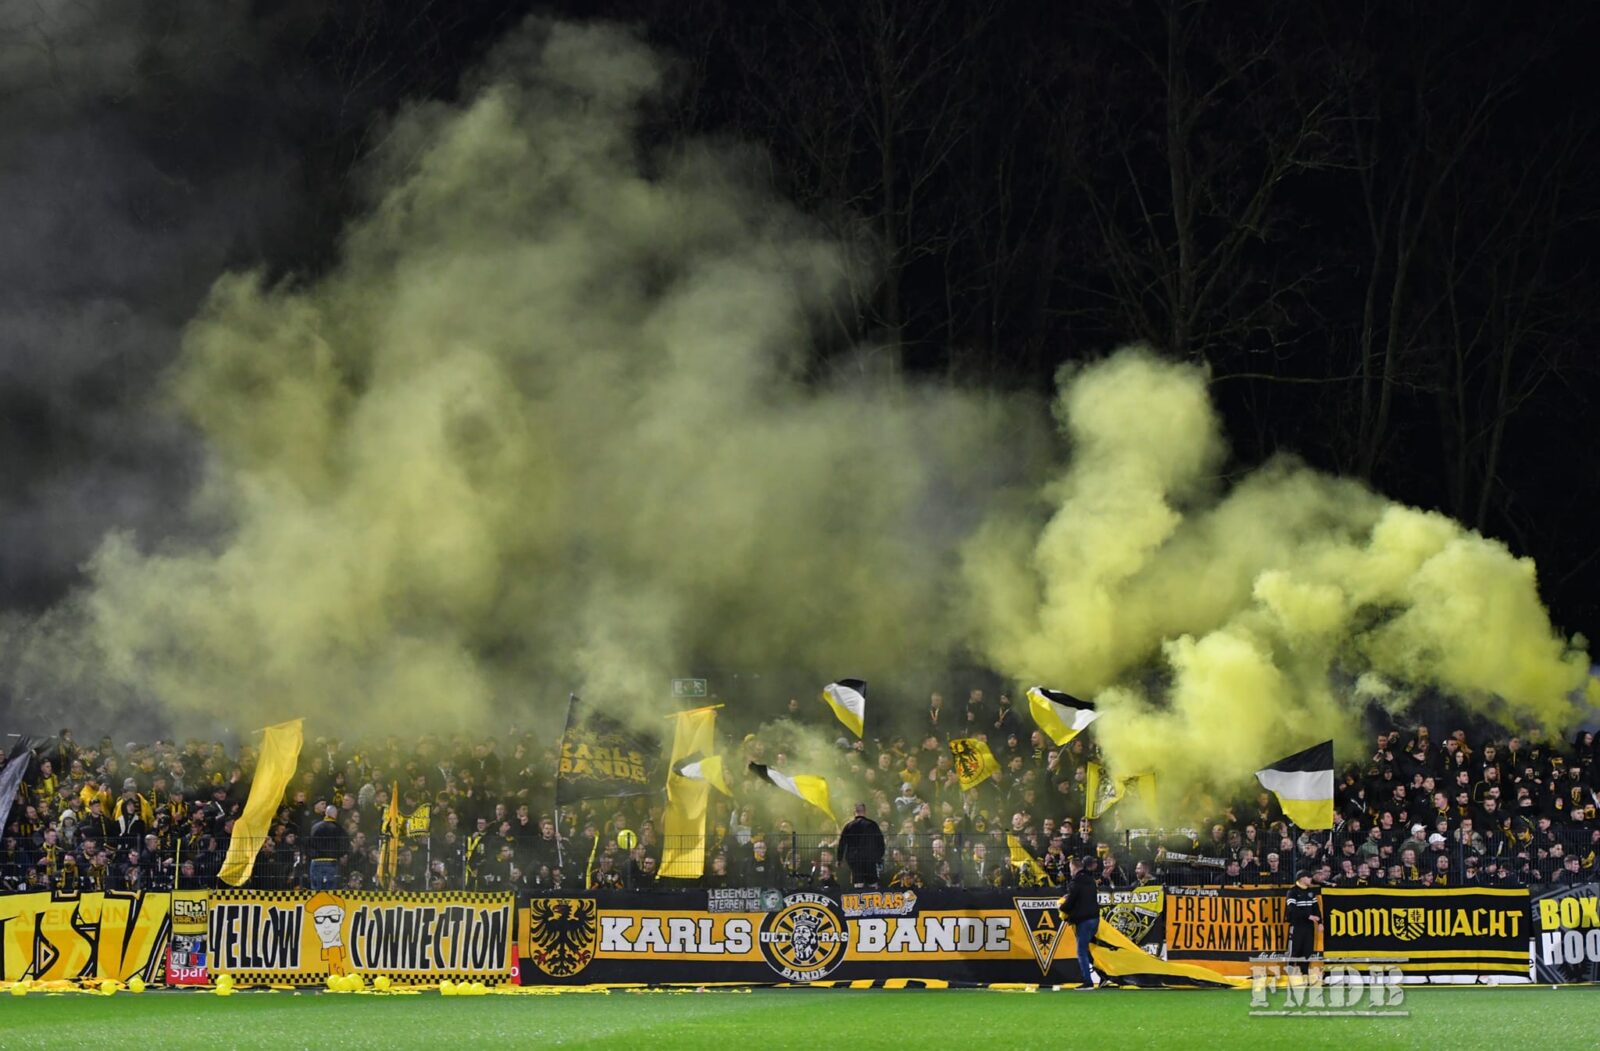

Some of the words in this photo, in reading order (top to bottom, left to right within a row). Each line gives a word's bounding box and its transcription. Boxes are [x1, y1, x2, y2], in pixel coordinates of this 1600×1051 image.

[784, 893, 831, 908] KARLS
[842, 892, 904, 910] ULTRAS
[1114, 891, 1159, 904] STADT
[1037, 910, 1055, 928] A
[1426, 908, 1523, 937] WACHT
[208, 905, 303, 968] YELLOW
[350, 906, 509, 969] CONNECTION
[600, 917, 753, 953] KARLS
[857, 917, 1011, 953] BANDE
[782, 967, 829, 981] BANDE
